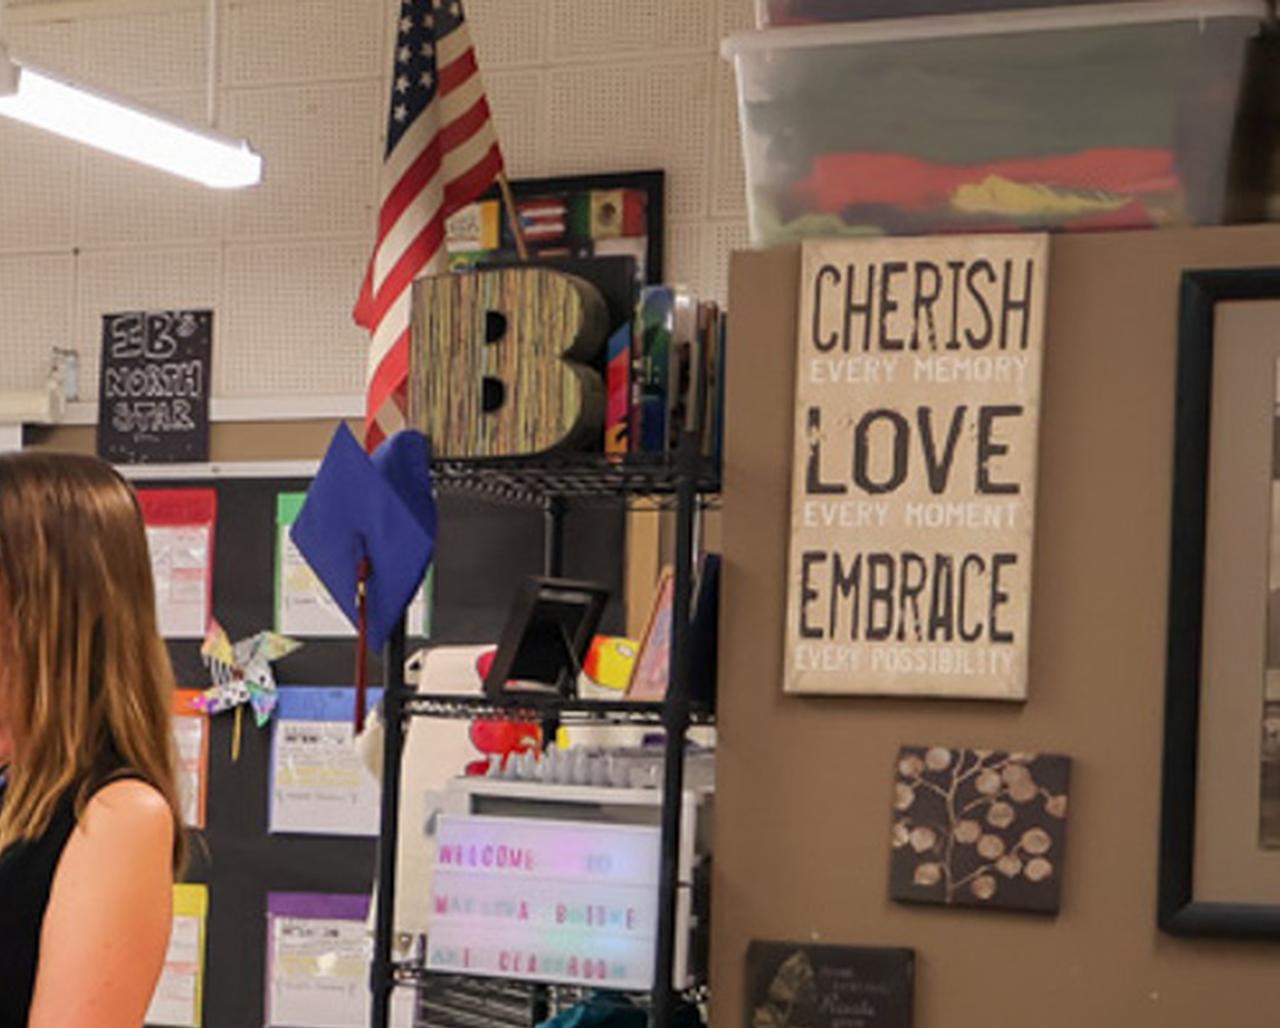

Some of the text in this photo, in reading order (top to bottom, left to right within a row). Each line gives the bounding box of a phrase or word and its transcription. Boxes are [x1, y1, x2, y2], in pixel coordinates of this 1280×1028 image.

[813, 258, 1033, 351] CHERISH
[105, 360, 202, 397] NORTH
[408, 266, 585, 458] B
[810, 355, 1028, 384] EVERY MEMORY
[112, 400, 195, 432] STAR
[806, 405, 1023, 495] LOVE
[803, 502, 1017, 529] EVERY MOMENT
[799, 551, 1018, 643] EMBRACE
[794, 645, 1014, 675] EVERY POSSIBILITY
[439, 844, 535, 871] WELCOME
